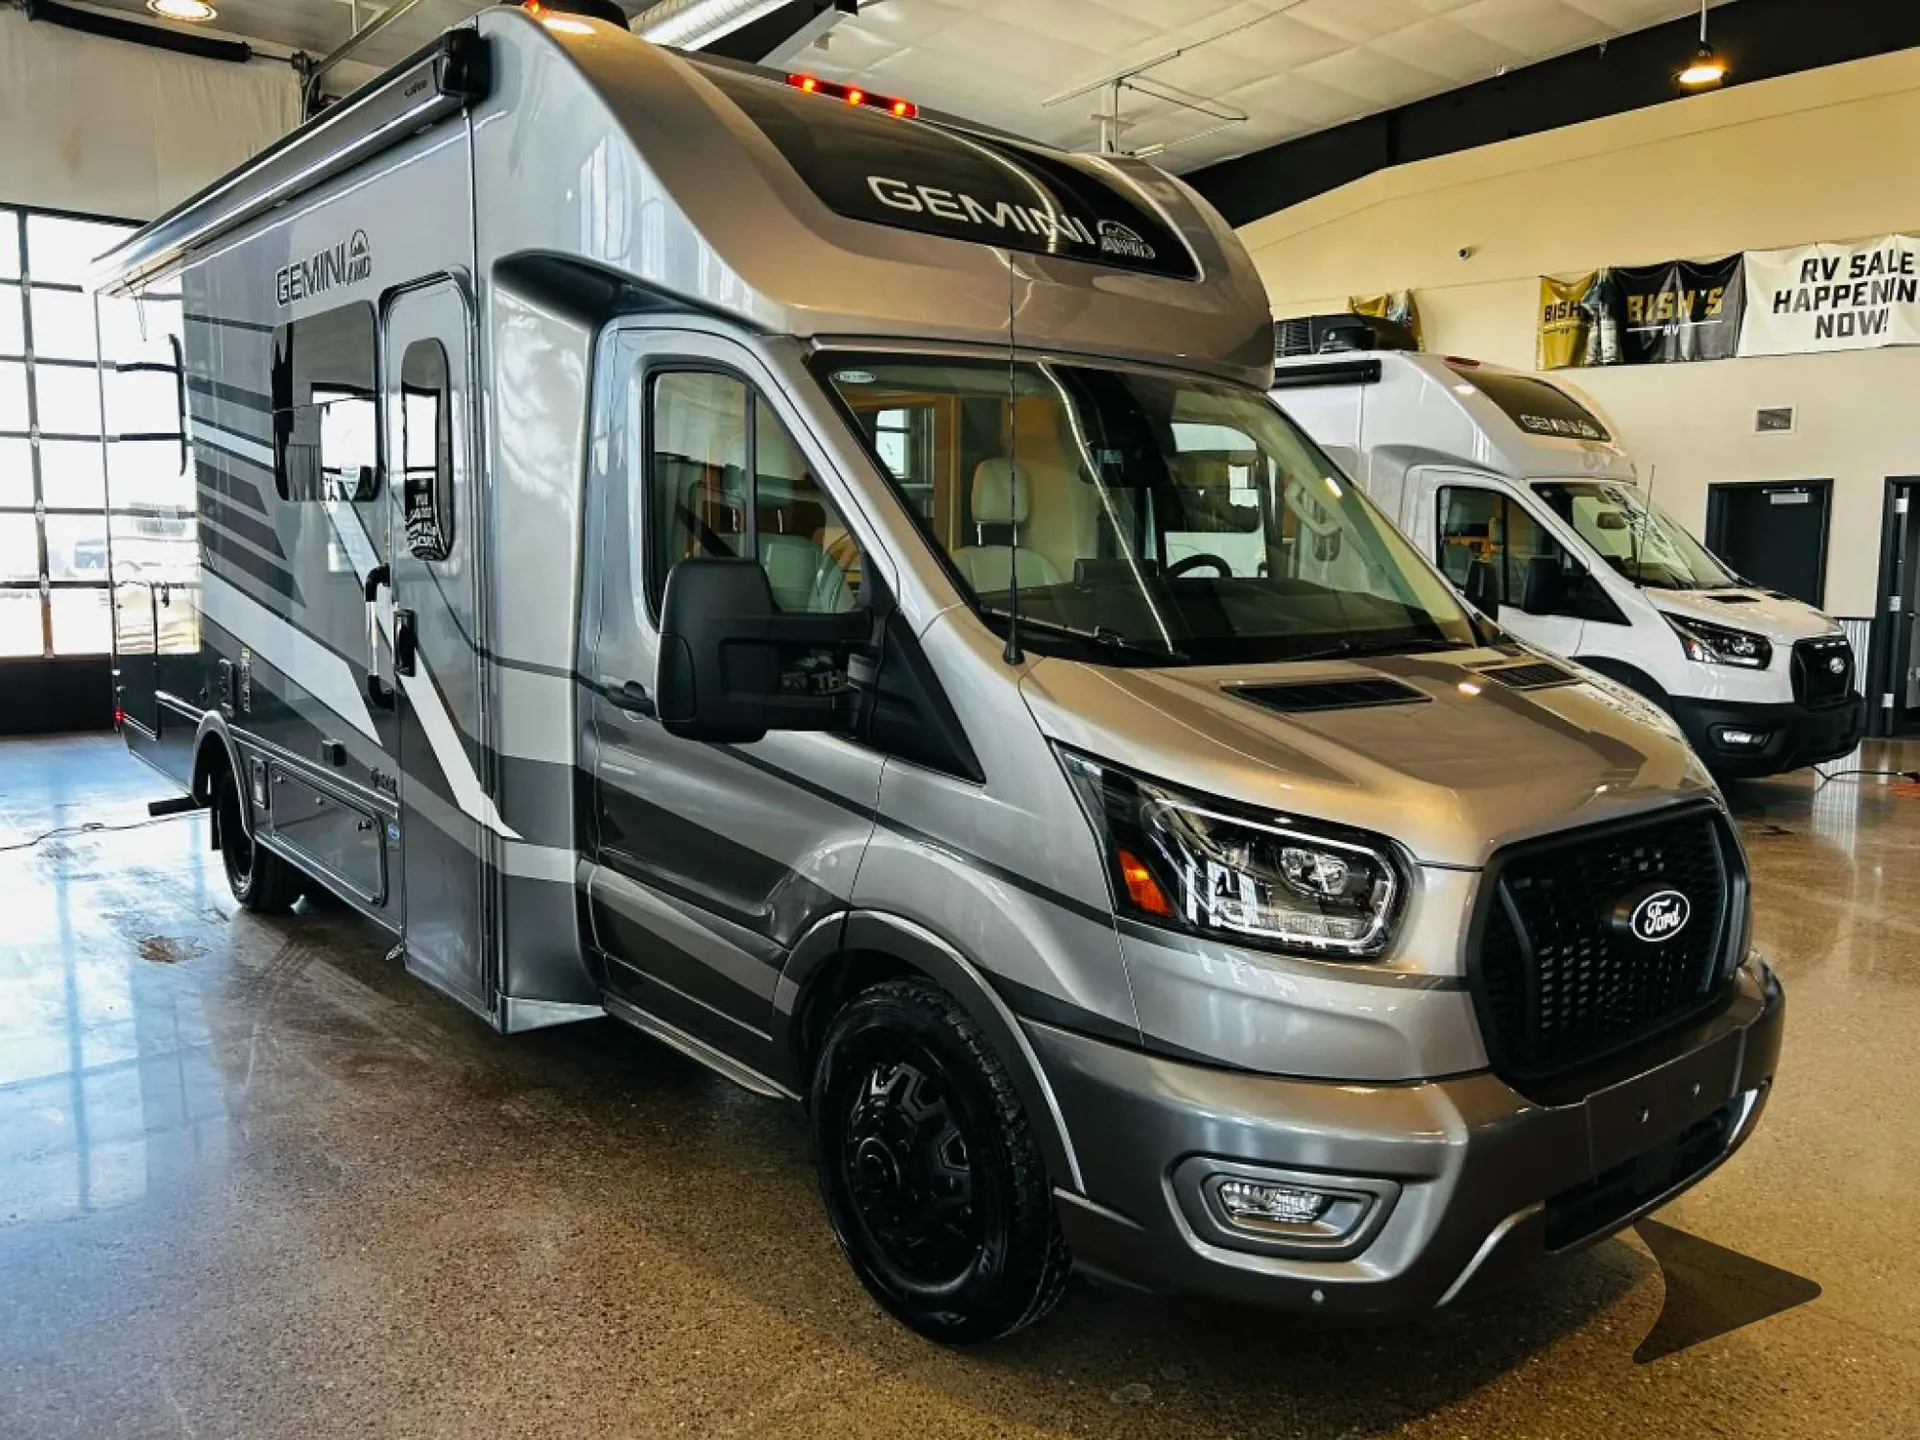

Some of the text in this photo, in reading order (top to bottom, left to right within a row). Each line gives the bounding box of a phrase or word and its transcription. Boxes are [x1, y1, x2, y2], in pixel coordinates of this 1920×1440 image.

[866, 175, 1096, 245] GEMINI
[276, 241, 346, 306] GEMINI
[1799, 248, 1915, 284] RV SALE
[1772, 277, 1920, 314] HAPPENIN
[1662, 325, 1679, 337] RV
[1814, 308, 1889, 340] NOW!
[1644, 898, 1680, 935] Ford
